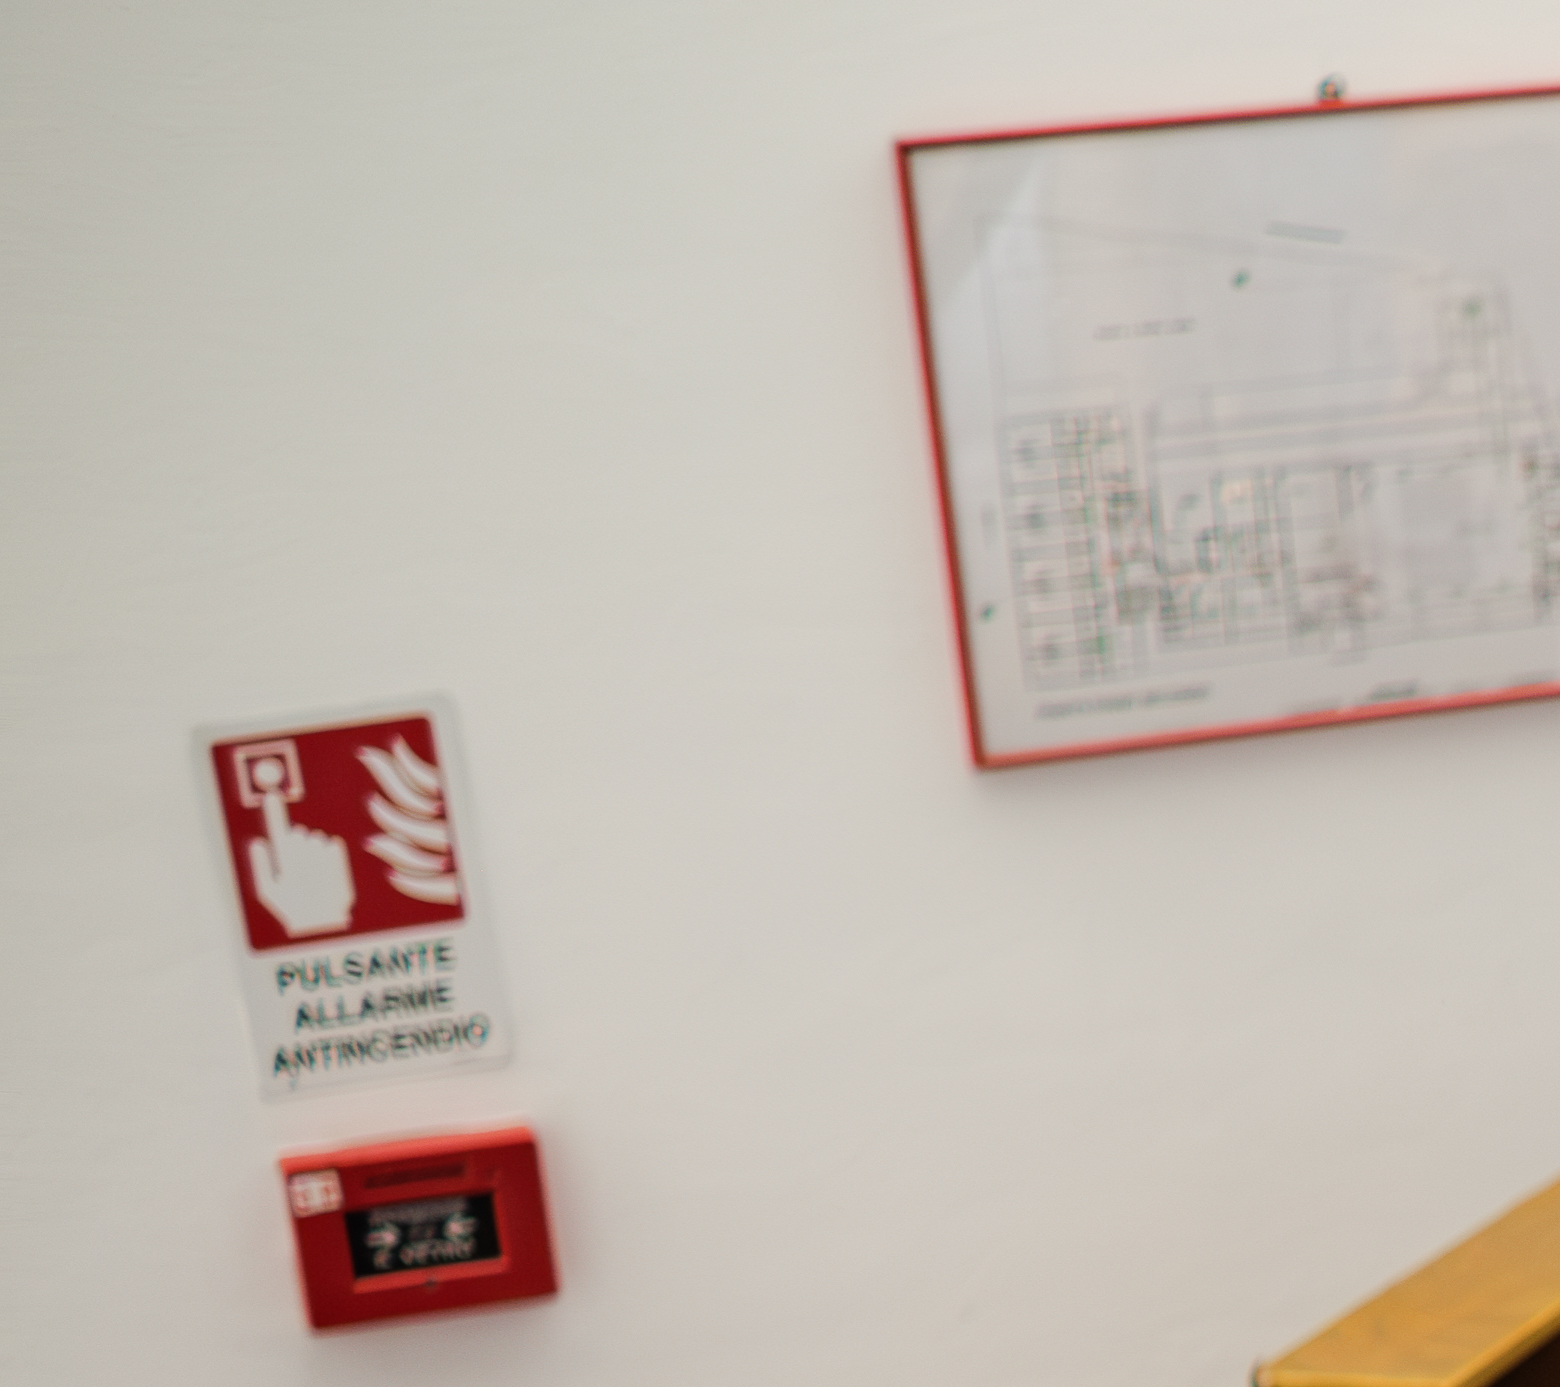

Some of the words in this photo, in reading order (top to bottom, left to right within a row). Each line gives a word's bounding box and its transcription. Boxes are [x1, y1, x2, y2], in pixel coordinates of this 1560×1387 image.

[275, 938, 458, 994] PULSANTE
[294, 978, 456, 1033] ALLARME
[272, 1012, 493, 1079] ANTINCENDIO
